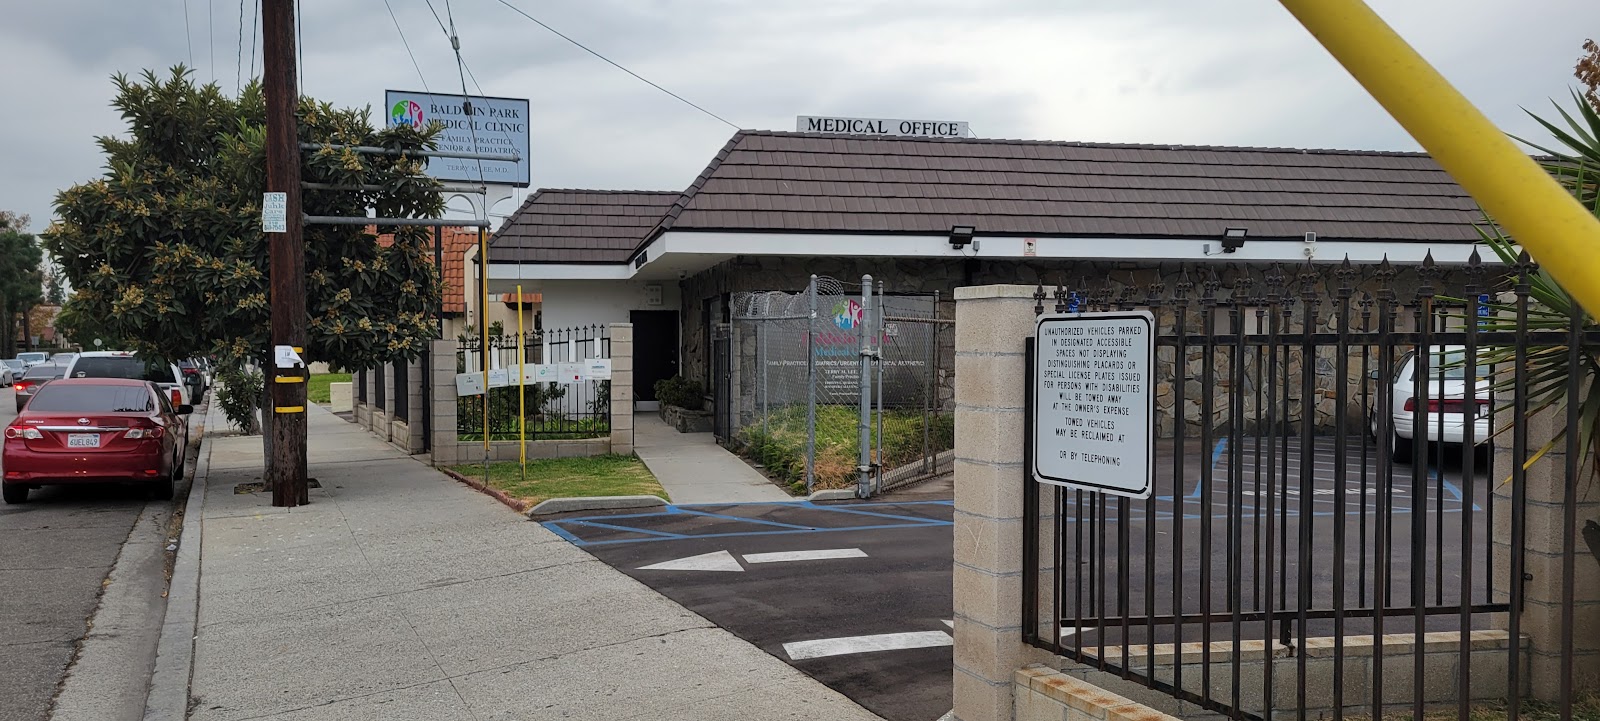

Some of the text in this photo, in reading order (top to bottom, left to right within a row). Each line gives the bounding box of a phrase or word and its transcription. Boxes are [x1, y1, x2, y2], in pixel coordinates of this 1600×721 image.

[430, 104, 520, 119] BALDIN PARK
[485, 122, 524, 133] CLINIC
[807, 118, 958, 136] MEDICAL OFFICE
[441, 135, 472, 143] FAMILY
[438, 144, 464, 152] ENIOR
[1044, 326, 1141, 336] UNAUTHORIZED VEHICLES PARKED
[1061, 338, 1093, 346] DESIGNATED
[1097, 338, 1132, 346] ACCESSIBLE
[1093, 350, 1127, 358] DISPLAYING
[1048, 360, 1136, 369] DISTINGUISHING PLACARDS OR
[1044, 370, 1141, 381] SPECIAL LICENSE PLATES ISSUED
[1044, 381, 1140, 393] FOR PERSONS WITH DISABILITIES
[1075, 393, 1082, 401] BE
[1085, 394, 1103, 403] TOWED
[1108, 395, 1122, 403] AWAY
[1052, 402, 1129, 416] AT THE OWNER'S EXPENSE
[1065, 417, 1115, 430] TOWED VEHICLES
[1056, 428, 1125, 443] MAY BE RECLAIMED AT
[1060, 450, 1121, 466] OR BY TELEPHONING
